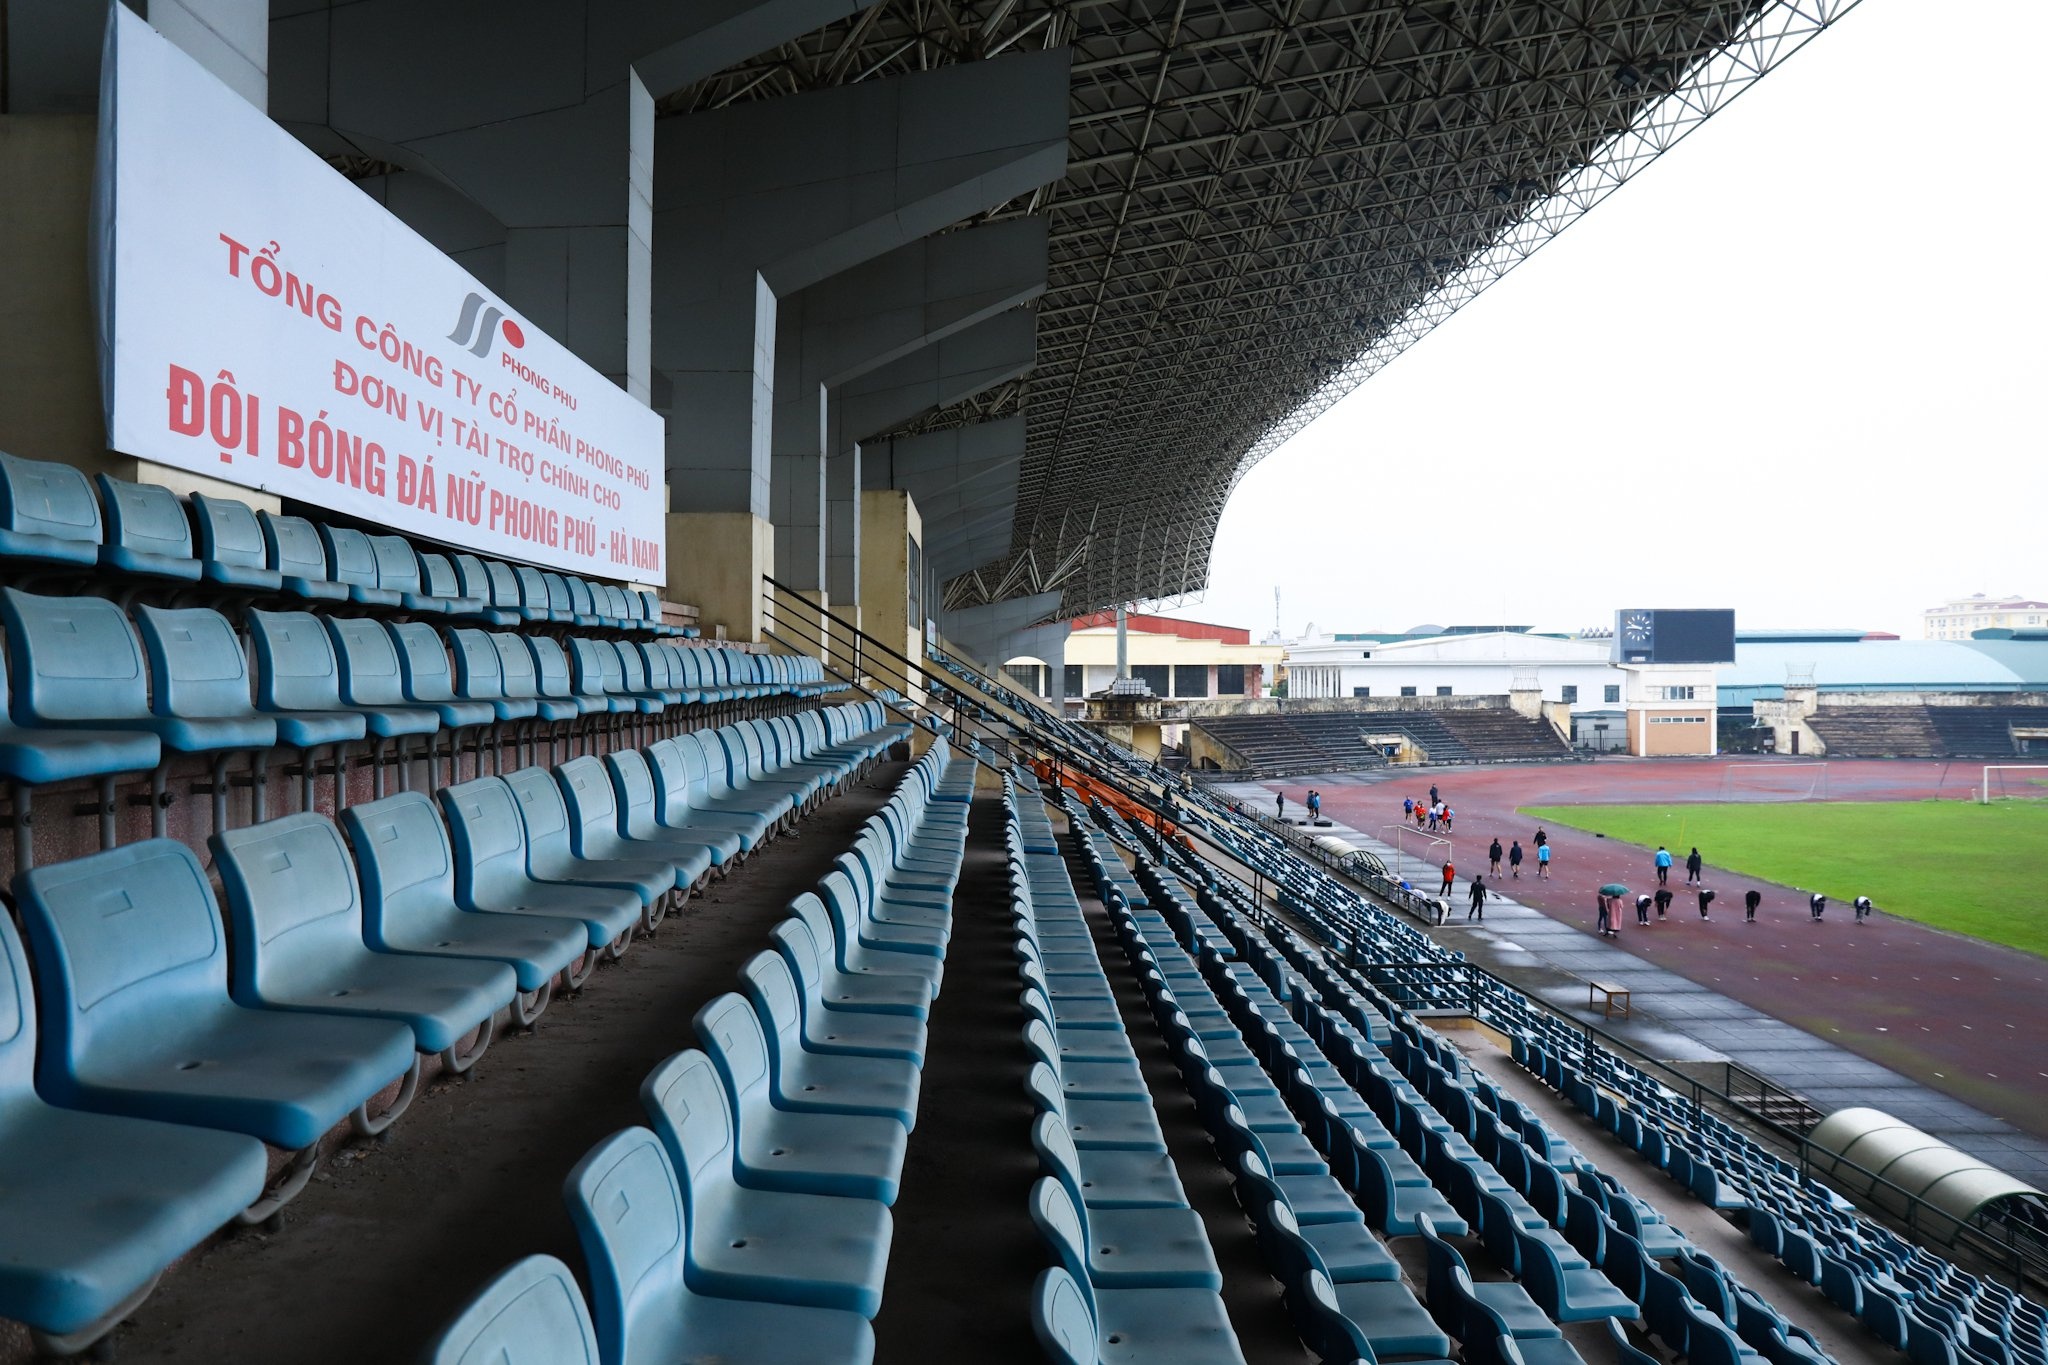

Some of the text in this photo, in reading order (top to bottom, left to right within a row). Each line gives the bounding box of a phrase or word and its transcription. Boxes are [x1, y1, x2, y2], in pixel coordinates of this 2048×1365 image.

[219, 232, 649, 490] TỔNG CÔNG TY CỔ PHẦN PHONG PHÚ
[333, 359, 621, 511] ĐƠN VỊ TÀI TRỢ CHÍNH CHO
[502, 352, 577, 411] PHONG PHU
[166, 363, 260, 464] ĐỘI
[278, 409, 386, 496] BÓNG
[397, 454, 437, 514] ĐÁ
[446, 470, 485, 526] NỮ
[489, 488, 558, 548] PHONG
[564, 516, 596, 557] PHÚ
[610, 527, 628, 564] HÀ
[632, 537, 659, 572] NAM
